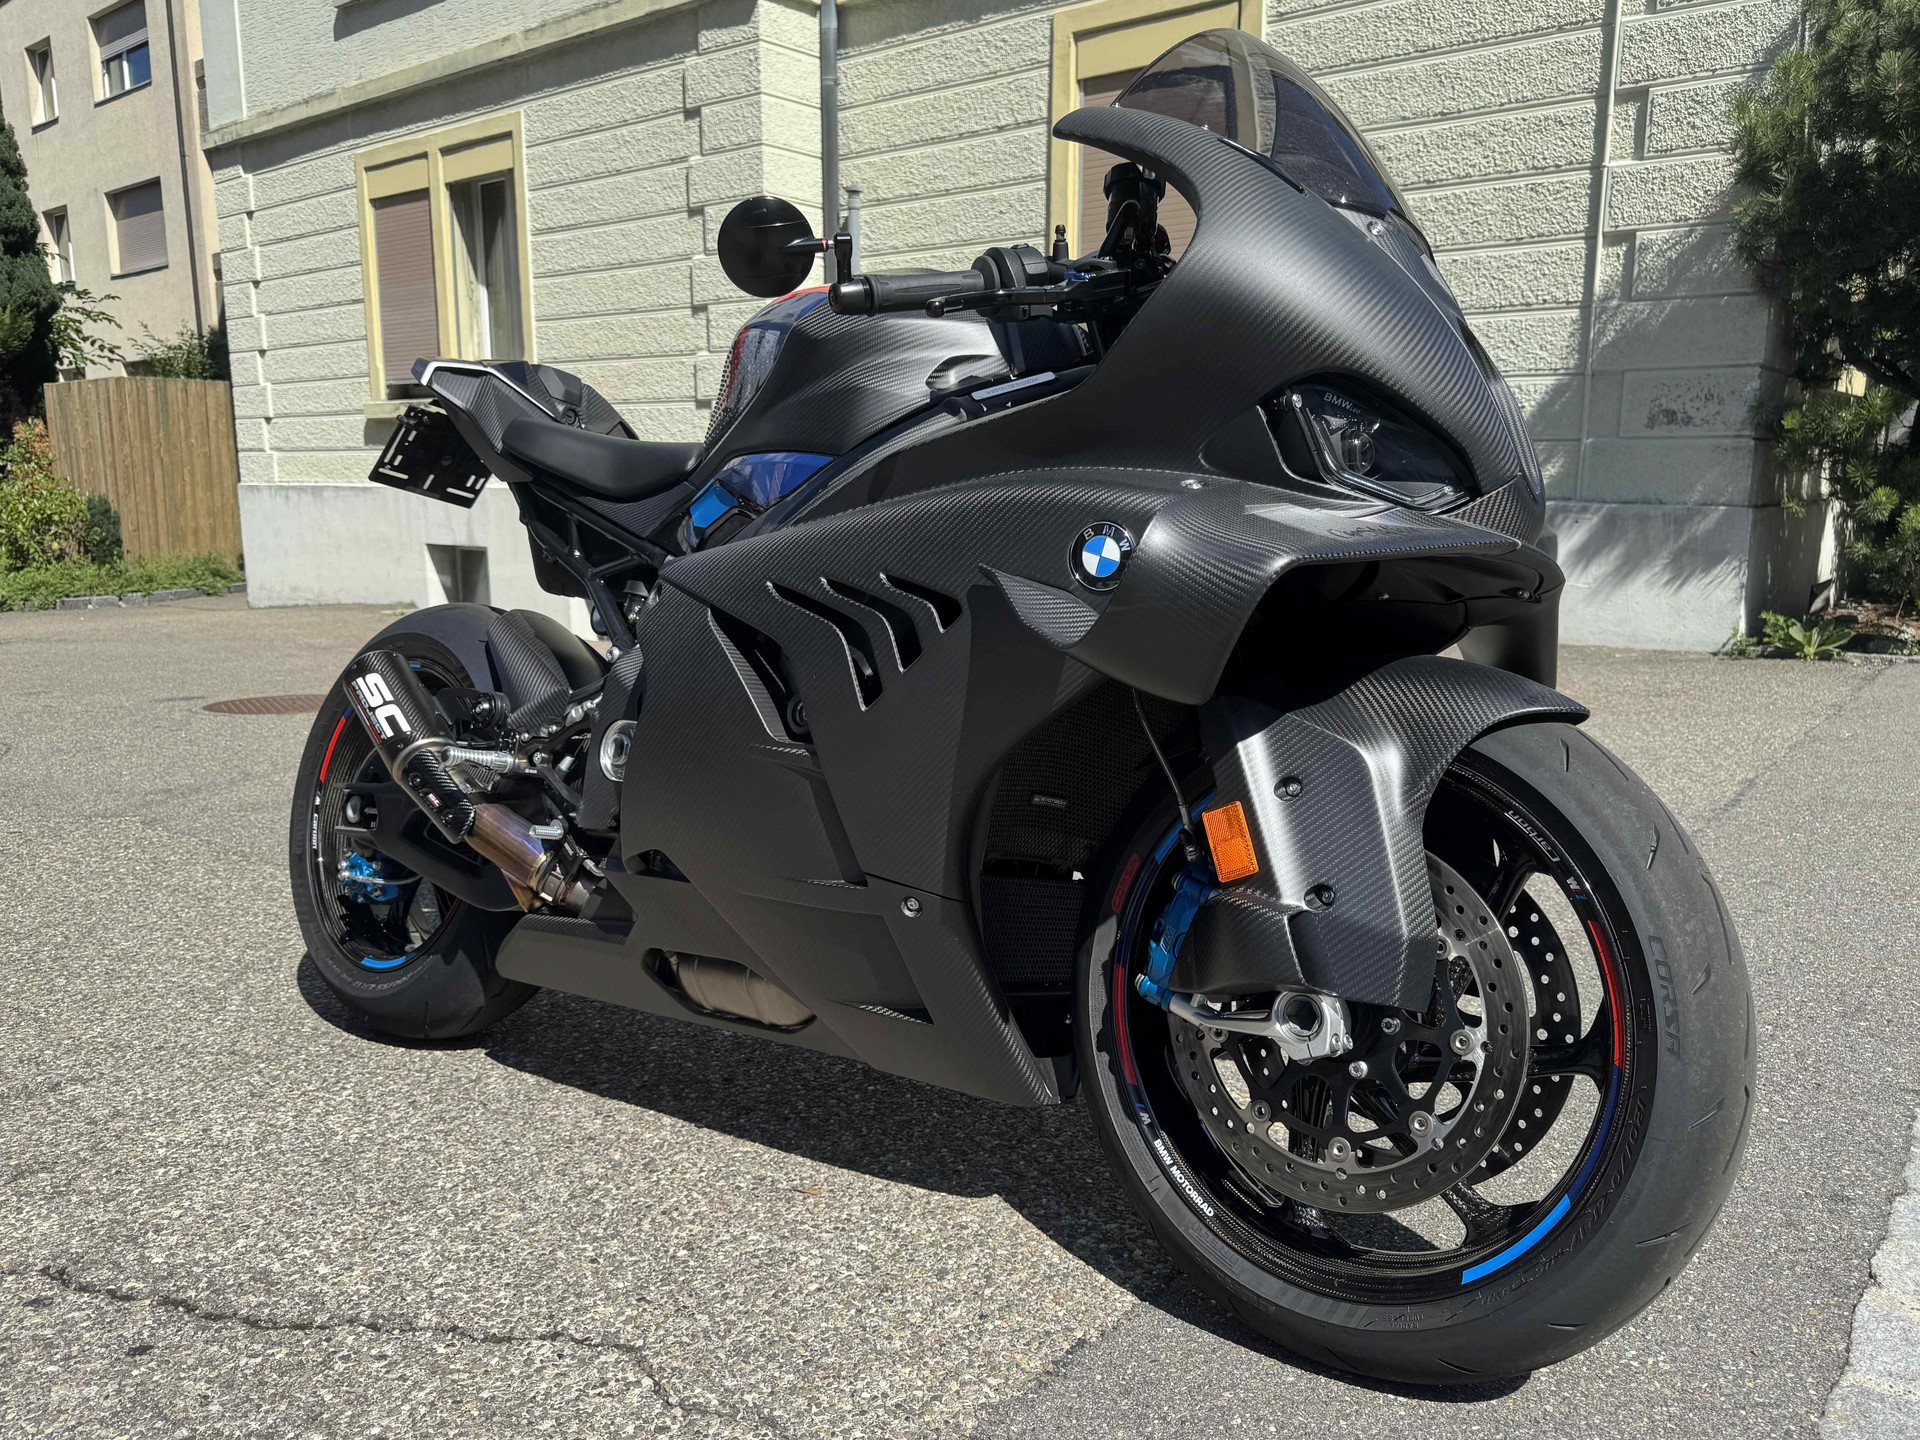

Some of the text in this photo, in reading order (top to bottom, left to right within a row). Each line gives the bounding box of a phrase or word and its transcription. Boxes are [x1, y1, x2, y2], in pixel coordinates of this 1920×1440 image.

[1323, 392, 1353, 410] BMW
[1083, 524, 1131, 552] BMW
[351, 680, 388, 740] PROJECT
[356, 673, 412, 738] SC
[1504, 810, 1561, 863] carbon
[1113, 856, 1140, 909] CORSA
[1648, 935, 1681, 1061] CORSA
[1153, 1138, 1215, 1218] BMW MOTORRAD
